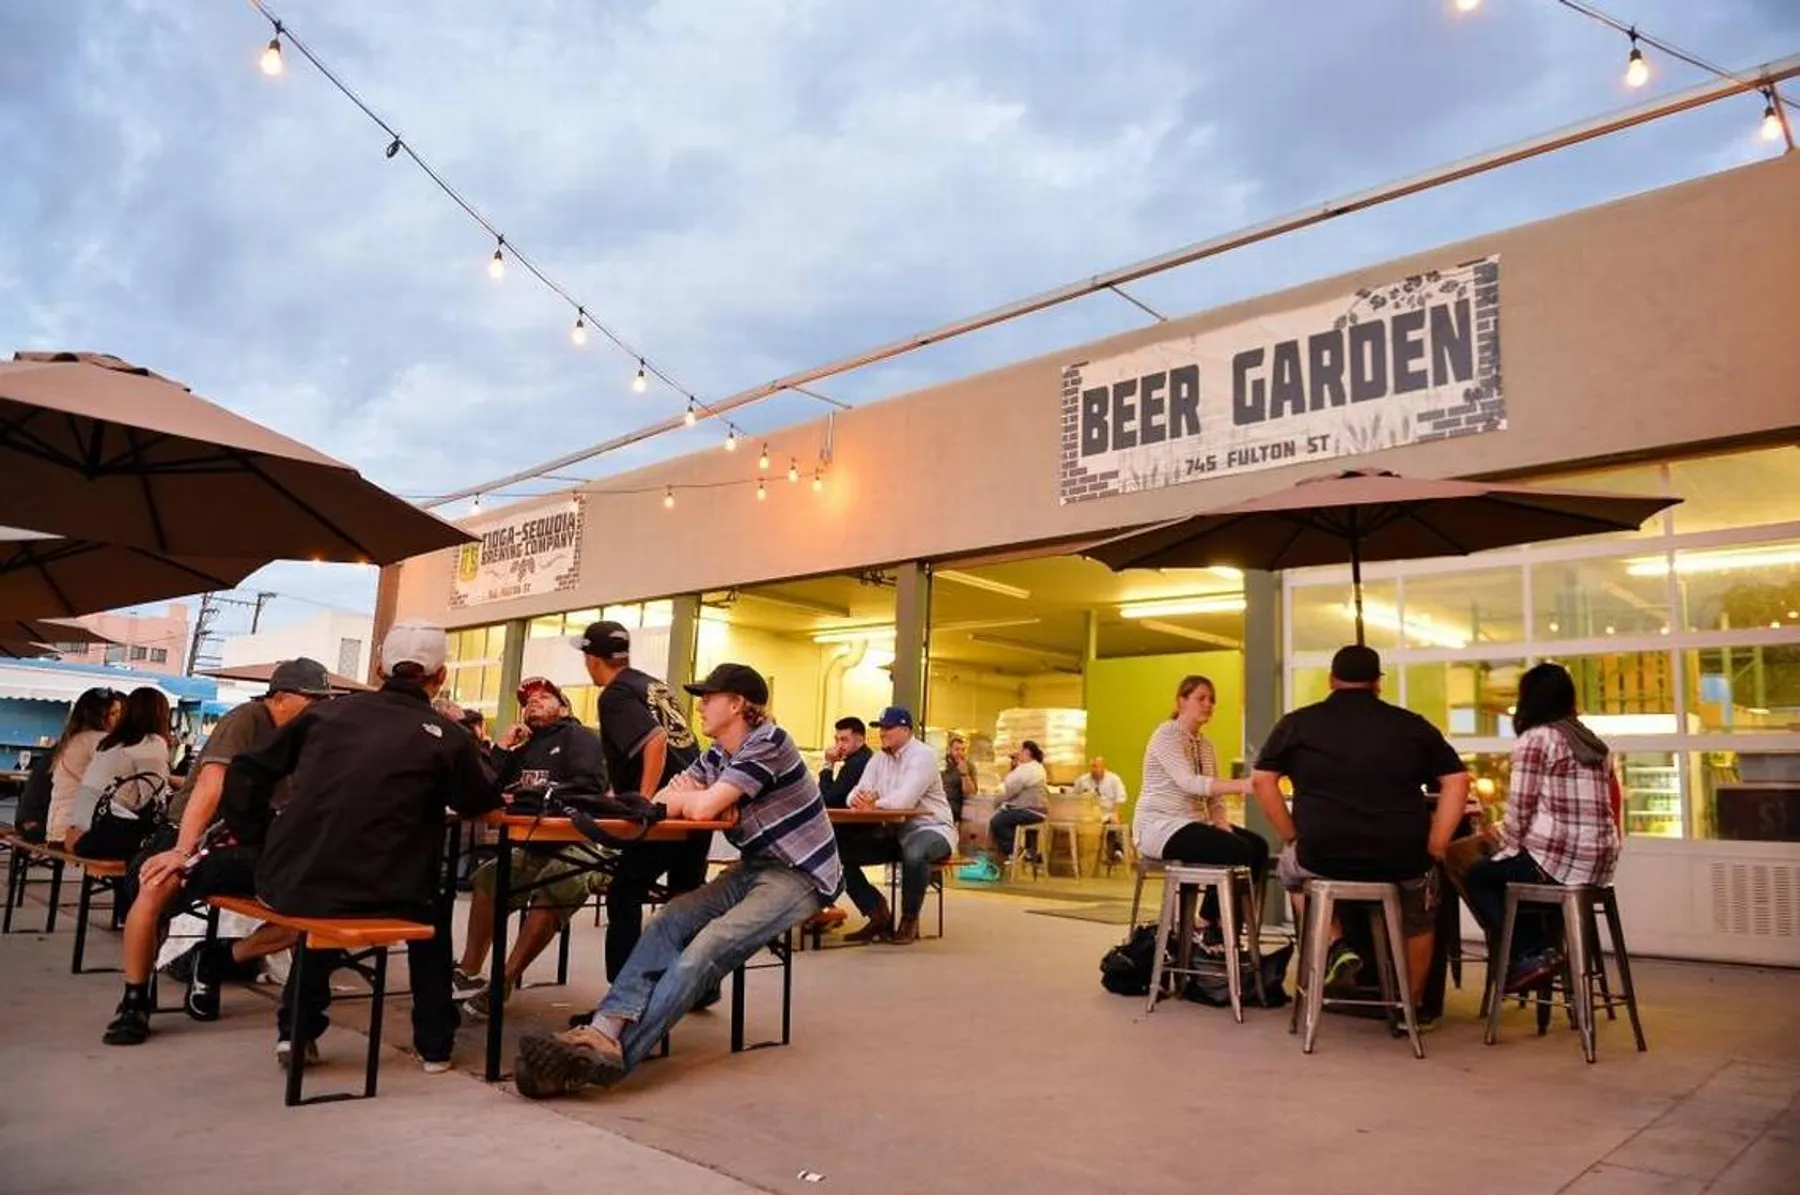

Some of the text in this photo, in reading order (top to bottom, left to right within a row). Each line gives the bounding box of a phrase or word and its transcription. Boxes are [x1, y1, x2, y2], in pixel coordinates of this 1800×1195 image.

[1081, 298, 1475, 458] BEER GARDEN
[1185, 434, 1330, 476] 745 FULTON ST
[481, 531, 576, 566] BREWING COMPANY
[482, 512, 576, 549] TIOGA-SEQUOIA
